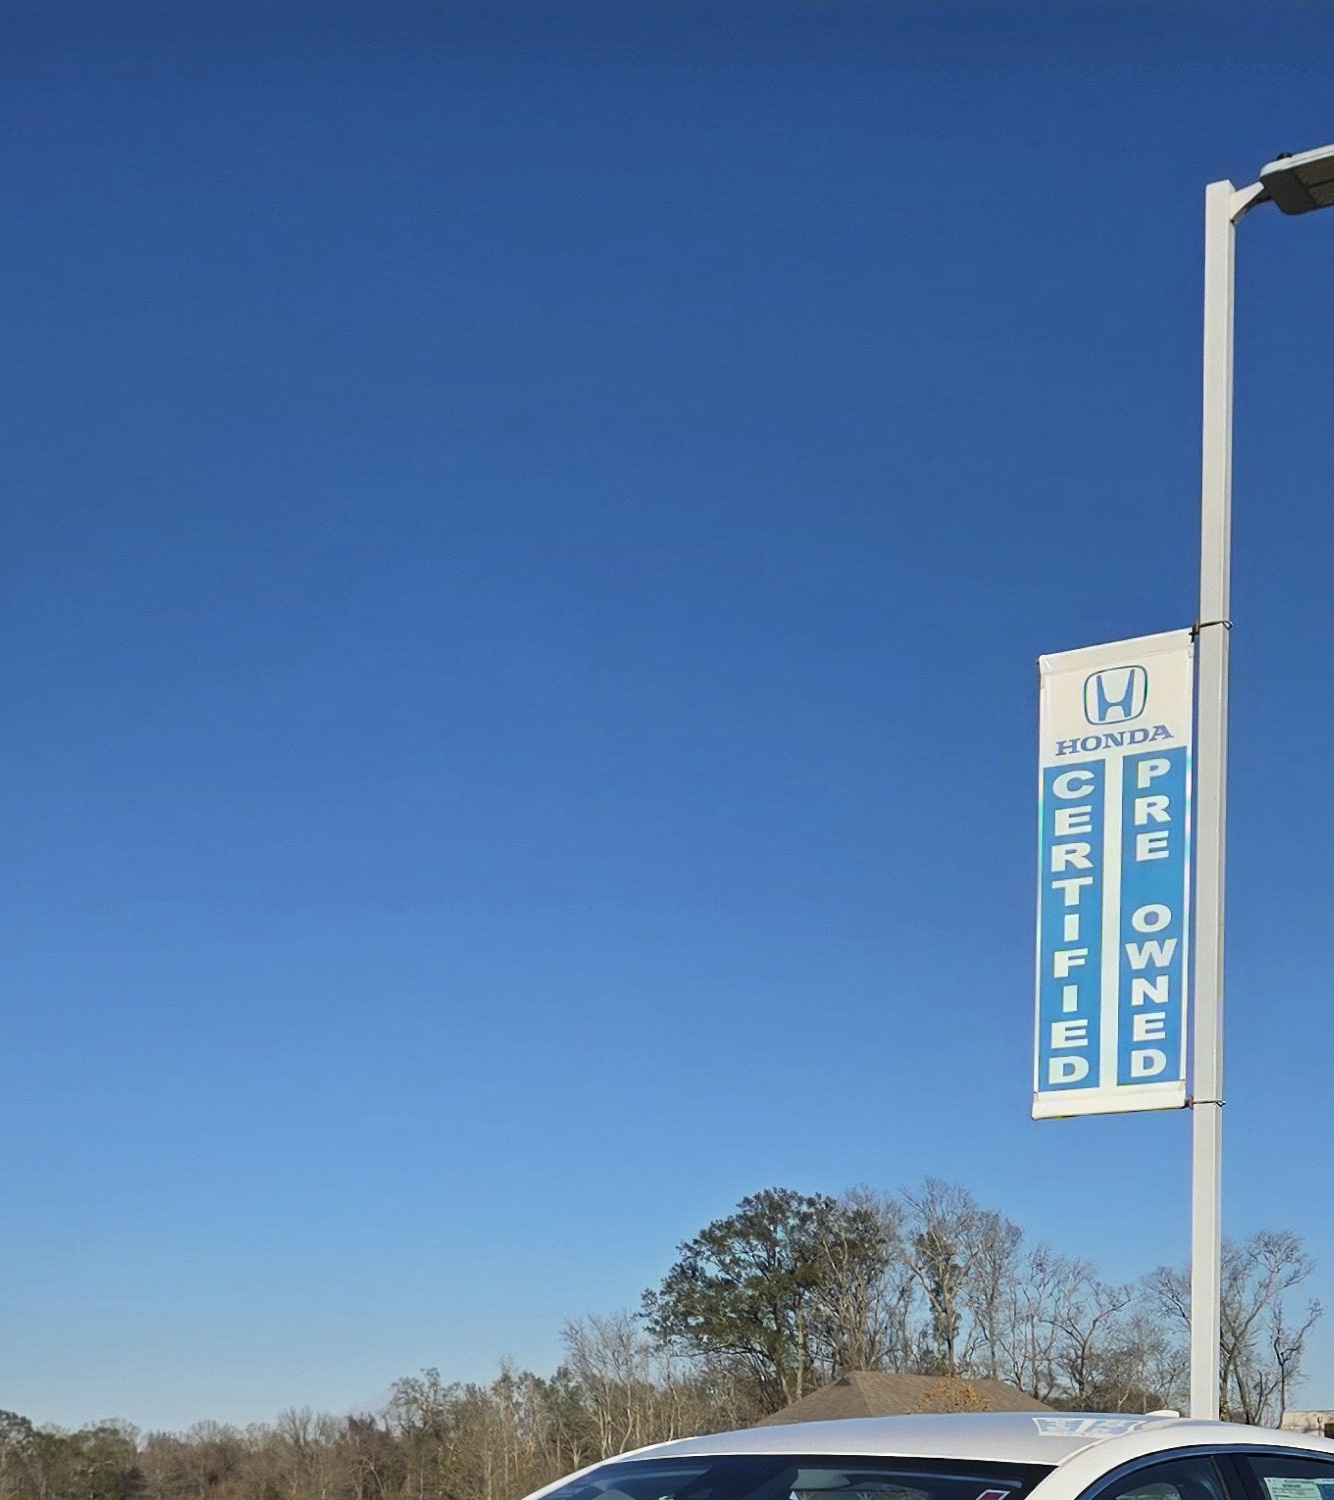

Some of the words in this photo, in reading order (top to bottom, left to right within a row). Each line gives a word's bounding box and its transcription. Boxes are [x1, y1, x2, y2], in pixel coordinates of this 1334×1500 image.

[1055, 724, 1174, 756] HONDA
[1134, 758, 1171, 862] PRE
[1049, 770, 1095, 1084] CERTIFIED
[1125, 904, 1177, 1078] OWNED
